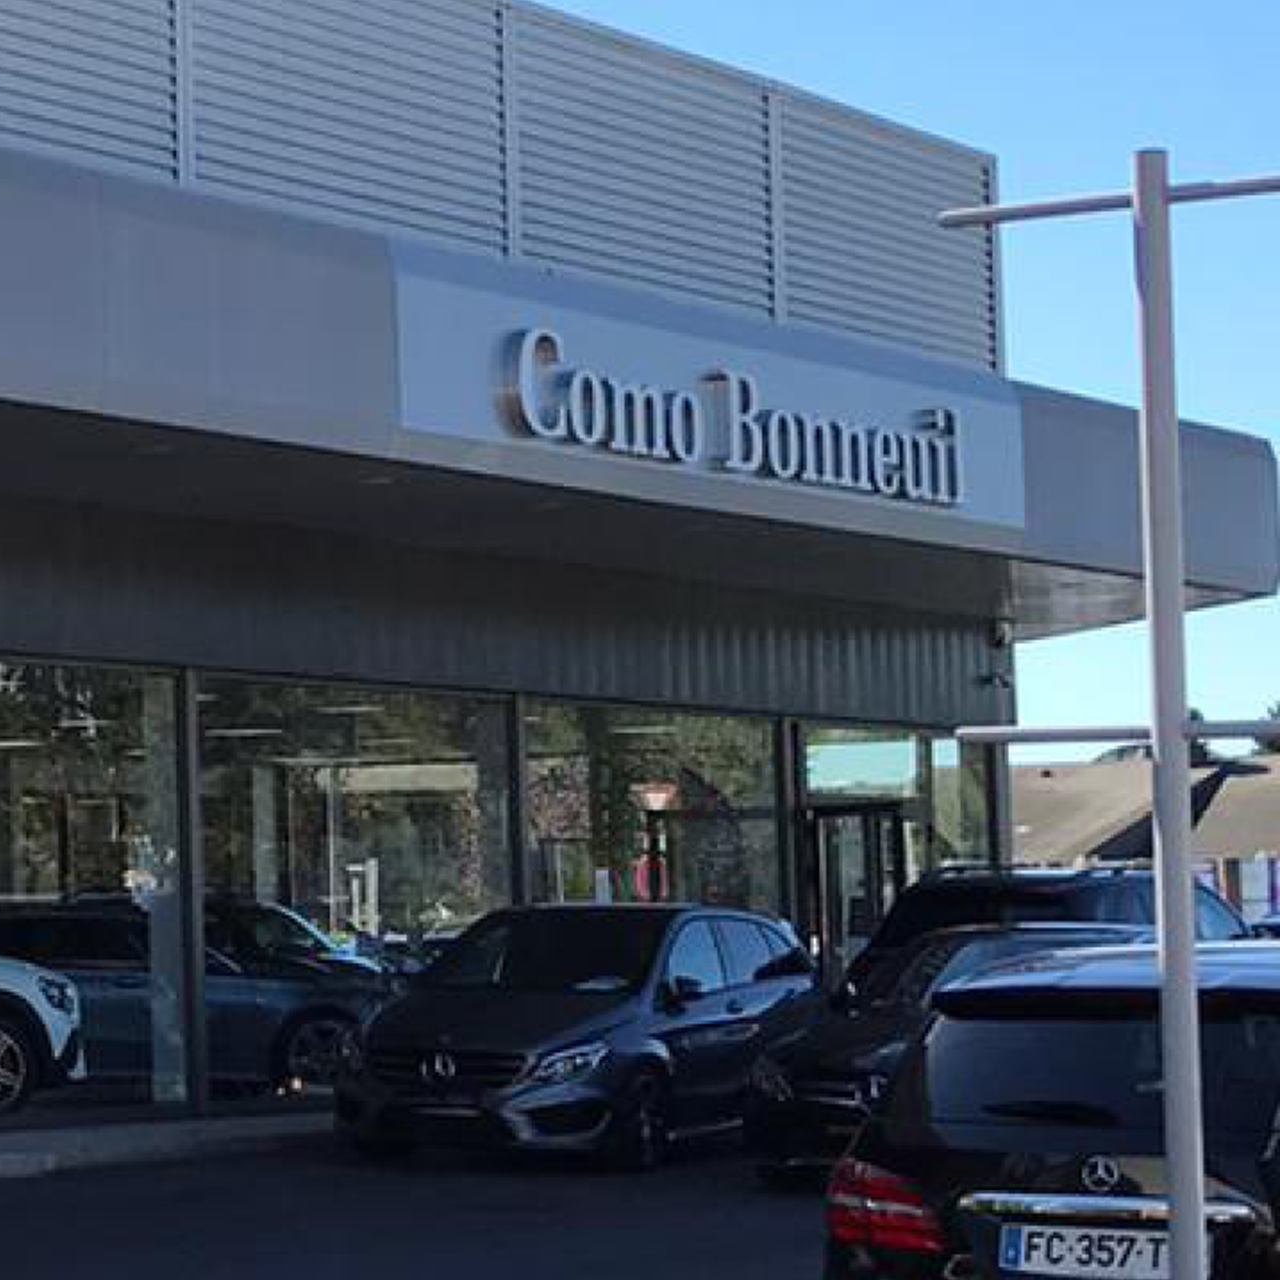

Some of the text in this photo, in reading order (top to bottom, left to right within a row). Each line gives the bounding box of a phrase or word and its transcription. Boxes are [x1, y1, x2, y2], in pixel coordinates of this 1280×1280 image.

[504, 327, 963, 505] Como Bonneuil
[1024, 1230, 1168, 1271] FC-357-T
